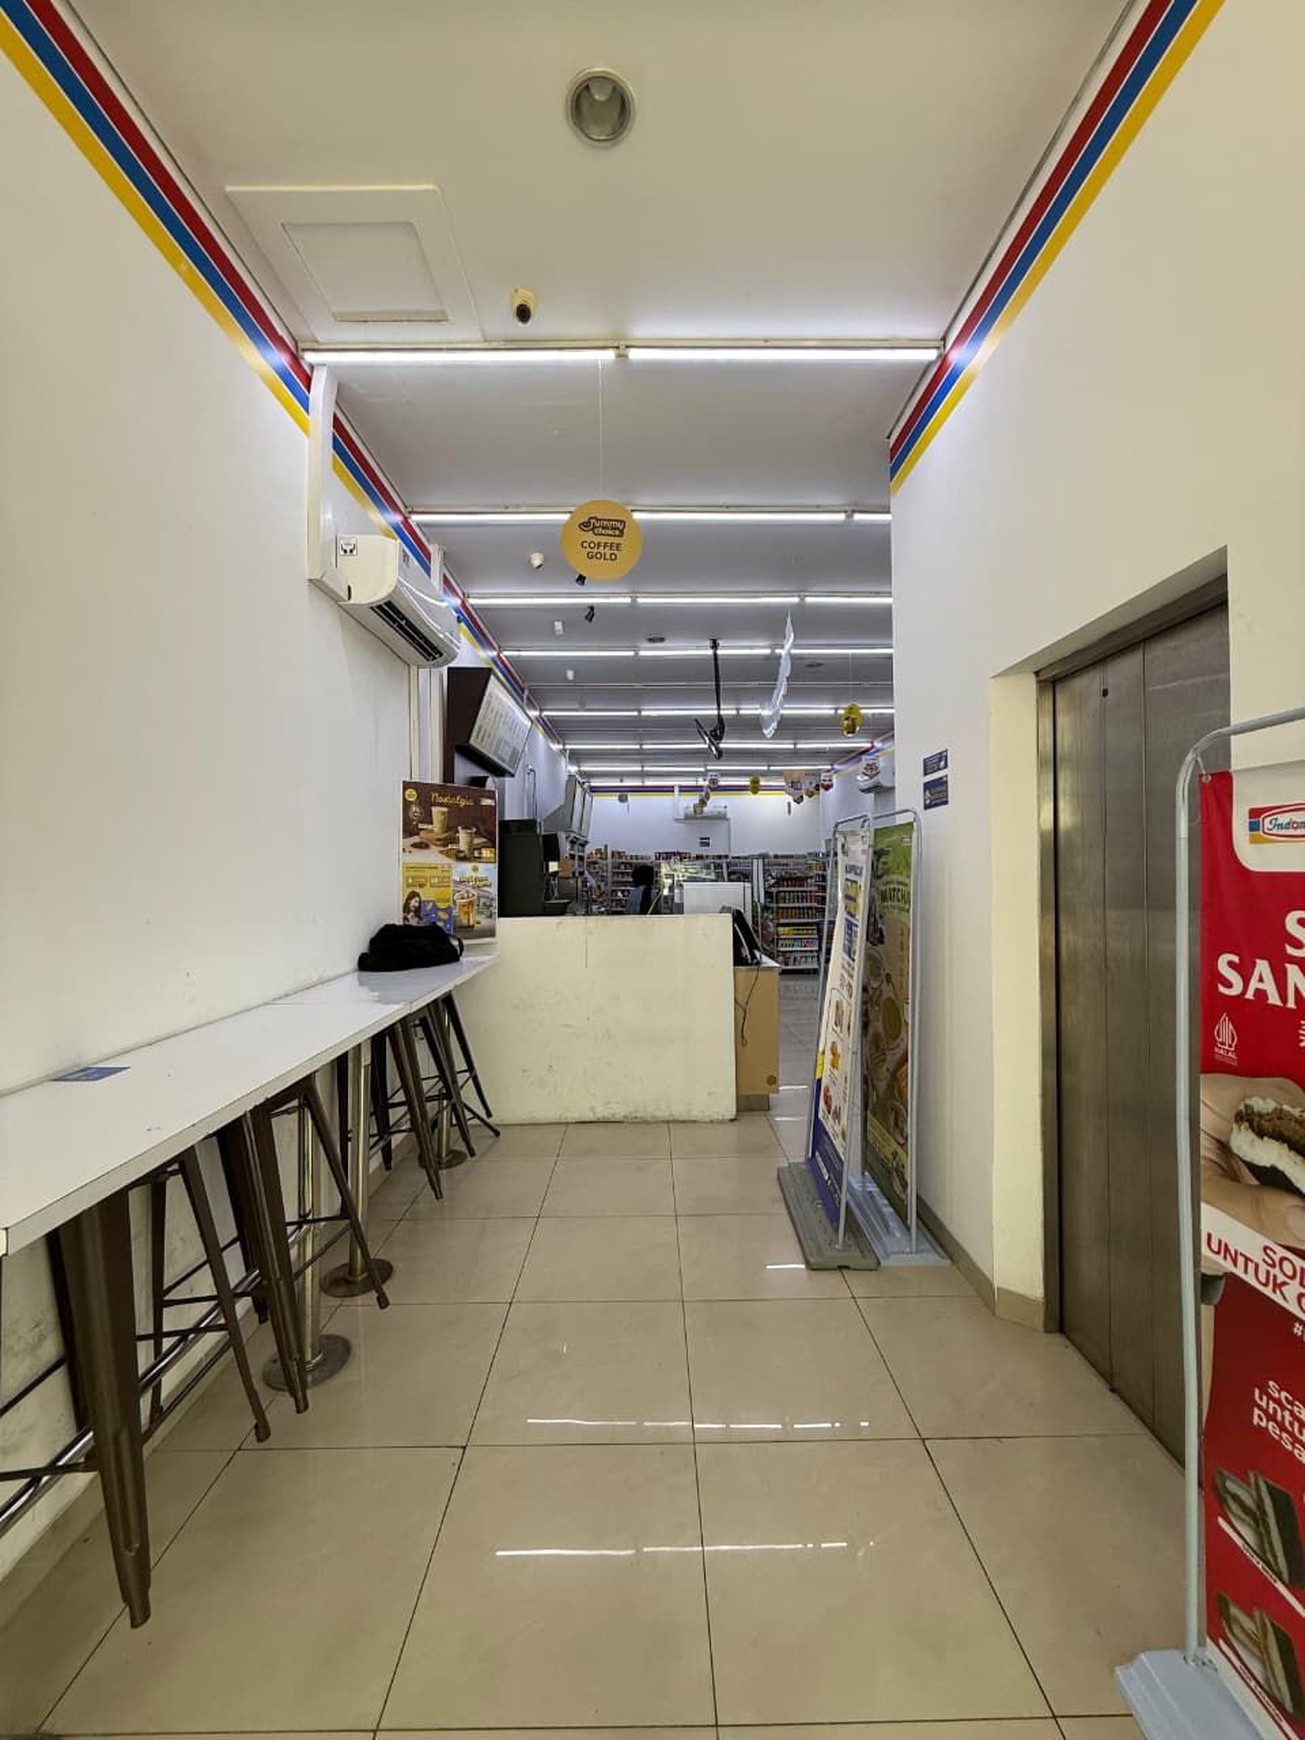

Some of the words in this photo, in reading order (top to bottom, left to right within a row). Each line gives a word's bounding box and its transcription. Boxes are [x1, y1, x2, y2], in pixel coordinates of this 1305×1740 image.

[581, 541, 623, 551] COFFEE
[587, 552, 618, 561] GOLD
[1206, 1232, 1291, 1304] UNTUK
